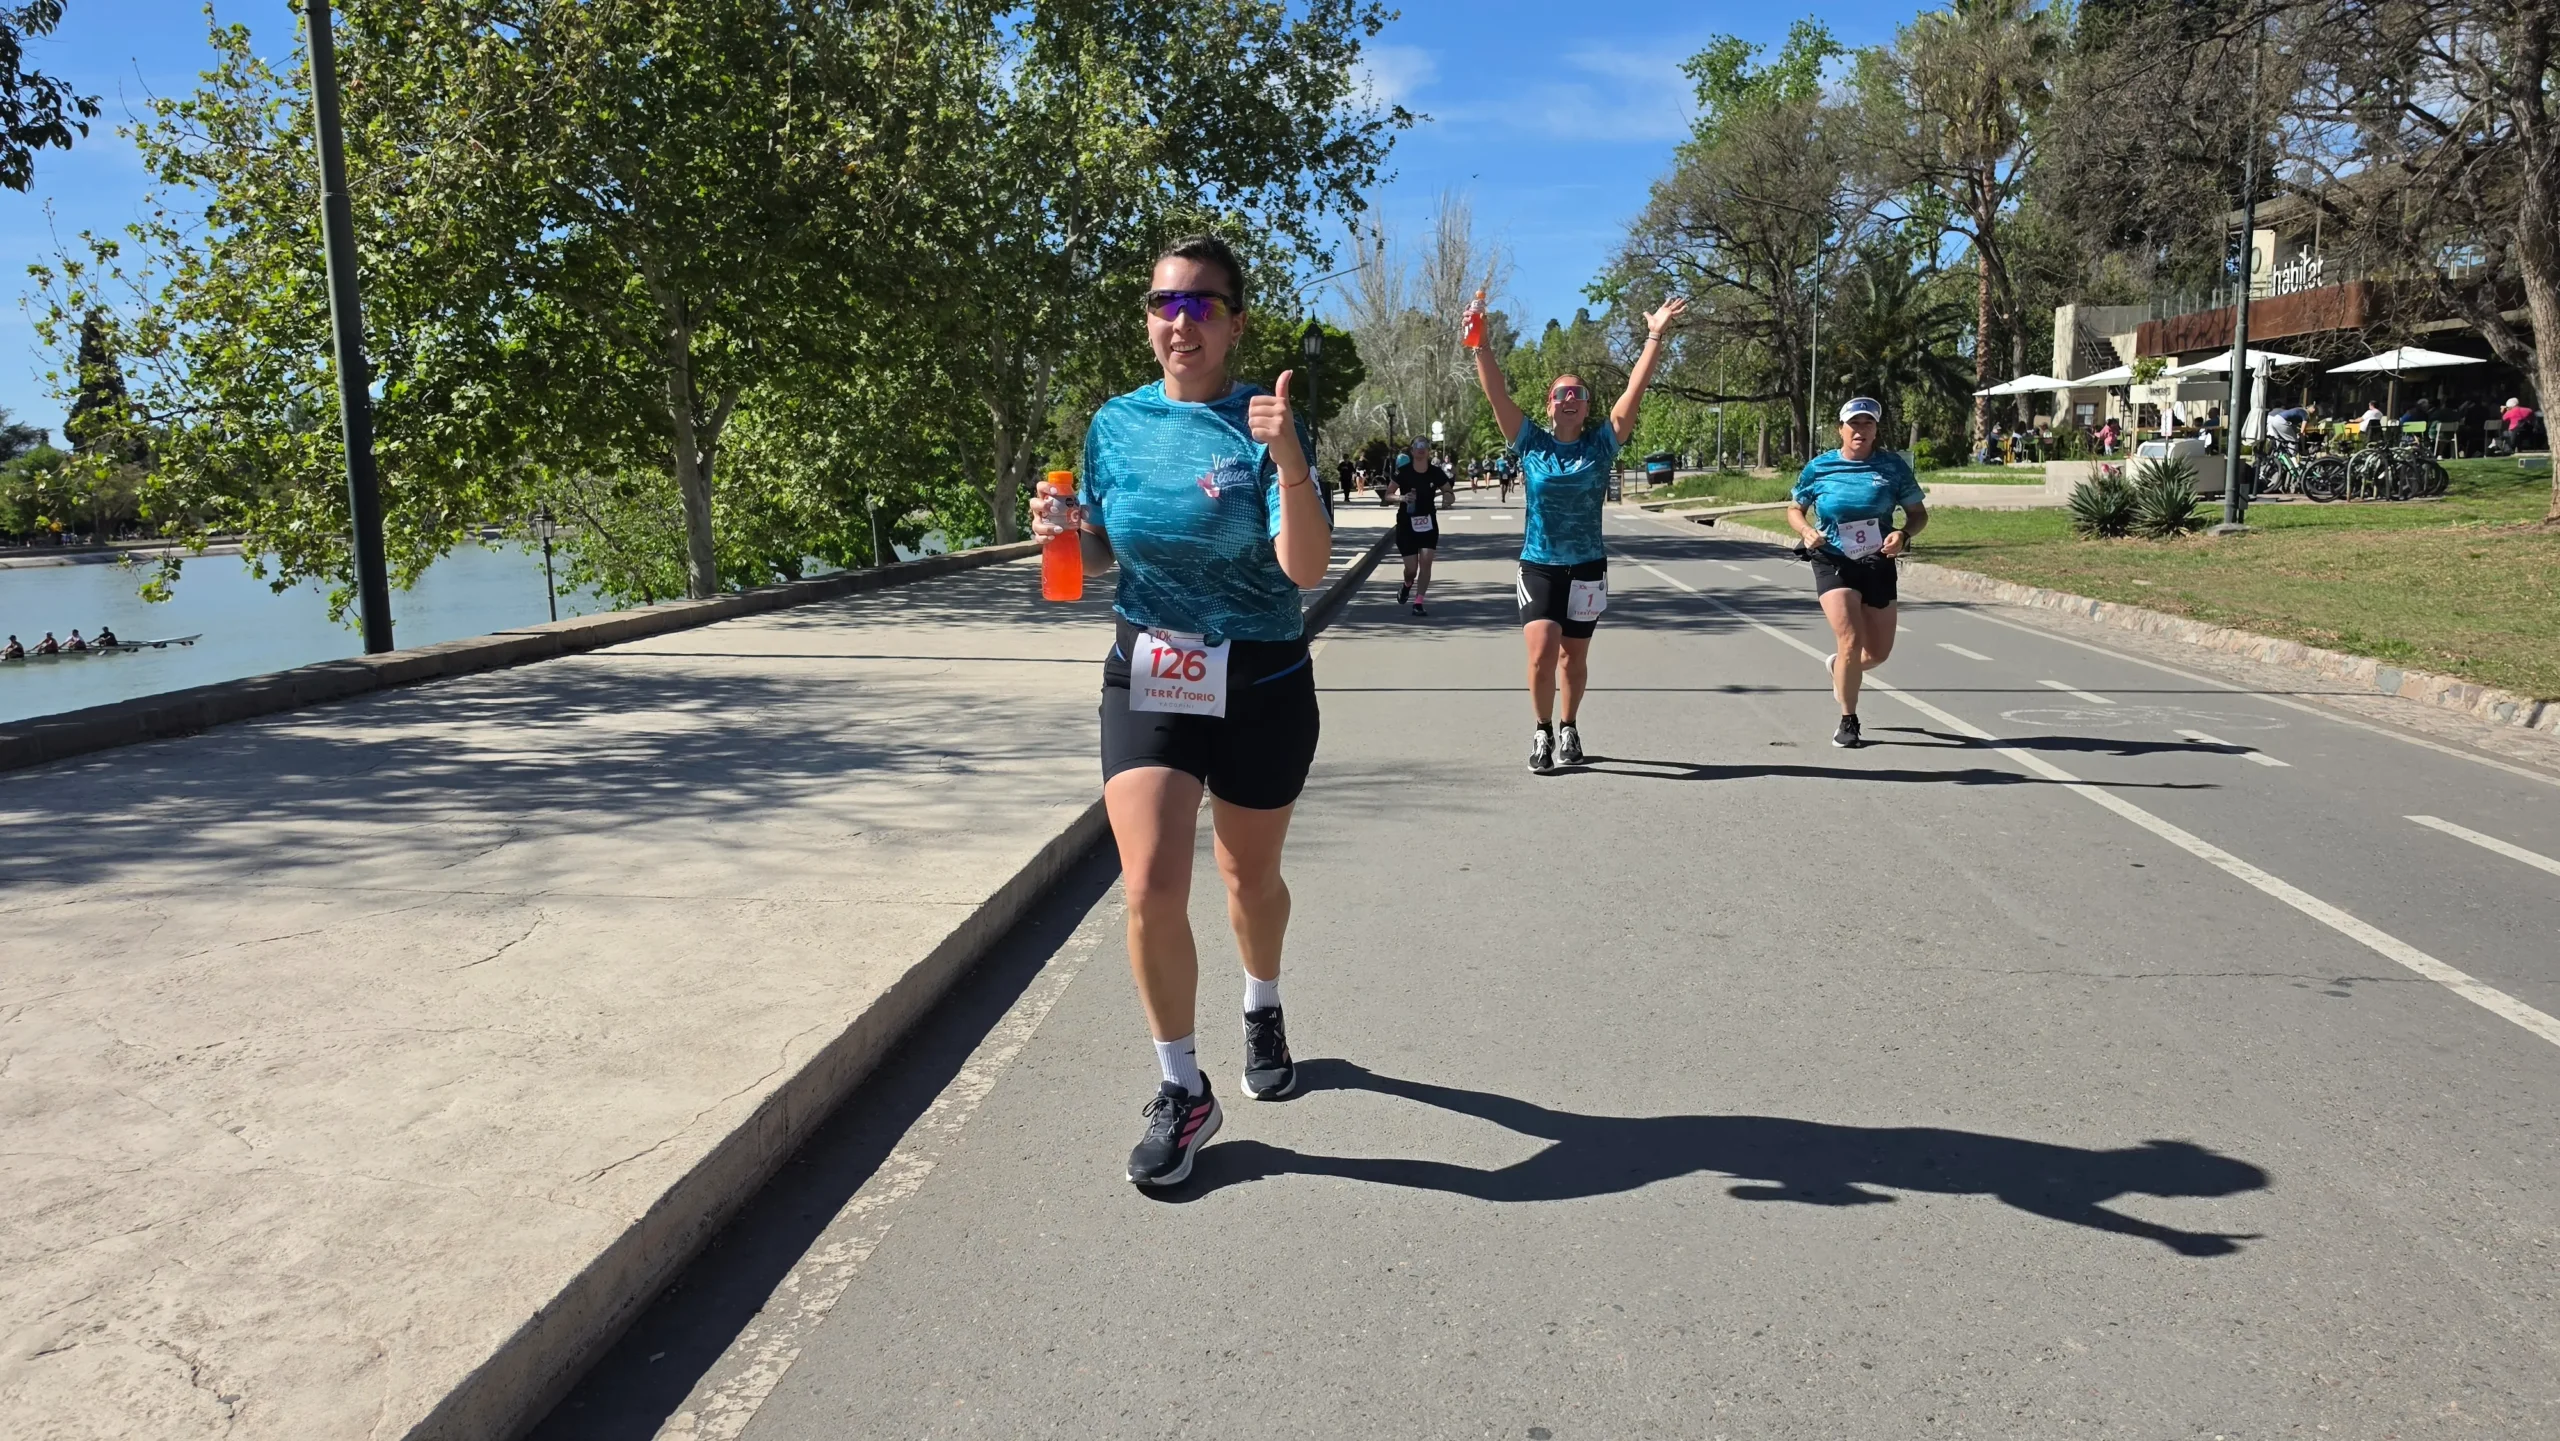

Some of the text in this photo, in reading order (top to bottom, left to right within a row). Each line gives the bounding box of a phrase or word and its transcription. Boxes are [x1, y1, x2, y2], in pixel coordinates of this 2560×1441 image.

[1855, 530, 1866, 544] 8
[1587, 593, 1594, 608] 1
[1155, 630, 1172, 642] 10k
[1150, 646, 1208, 682] 126
[1144, 685, 1216, 702] TERRITORIO
